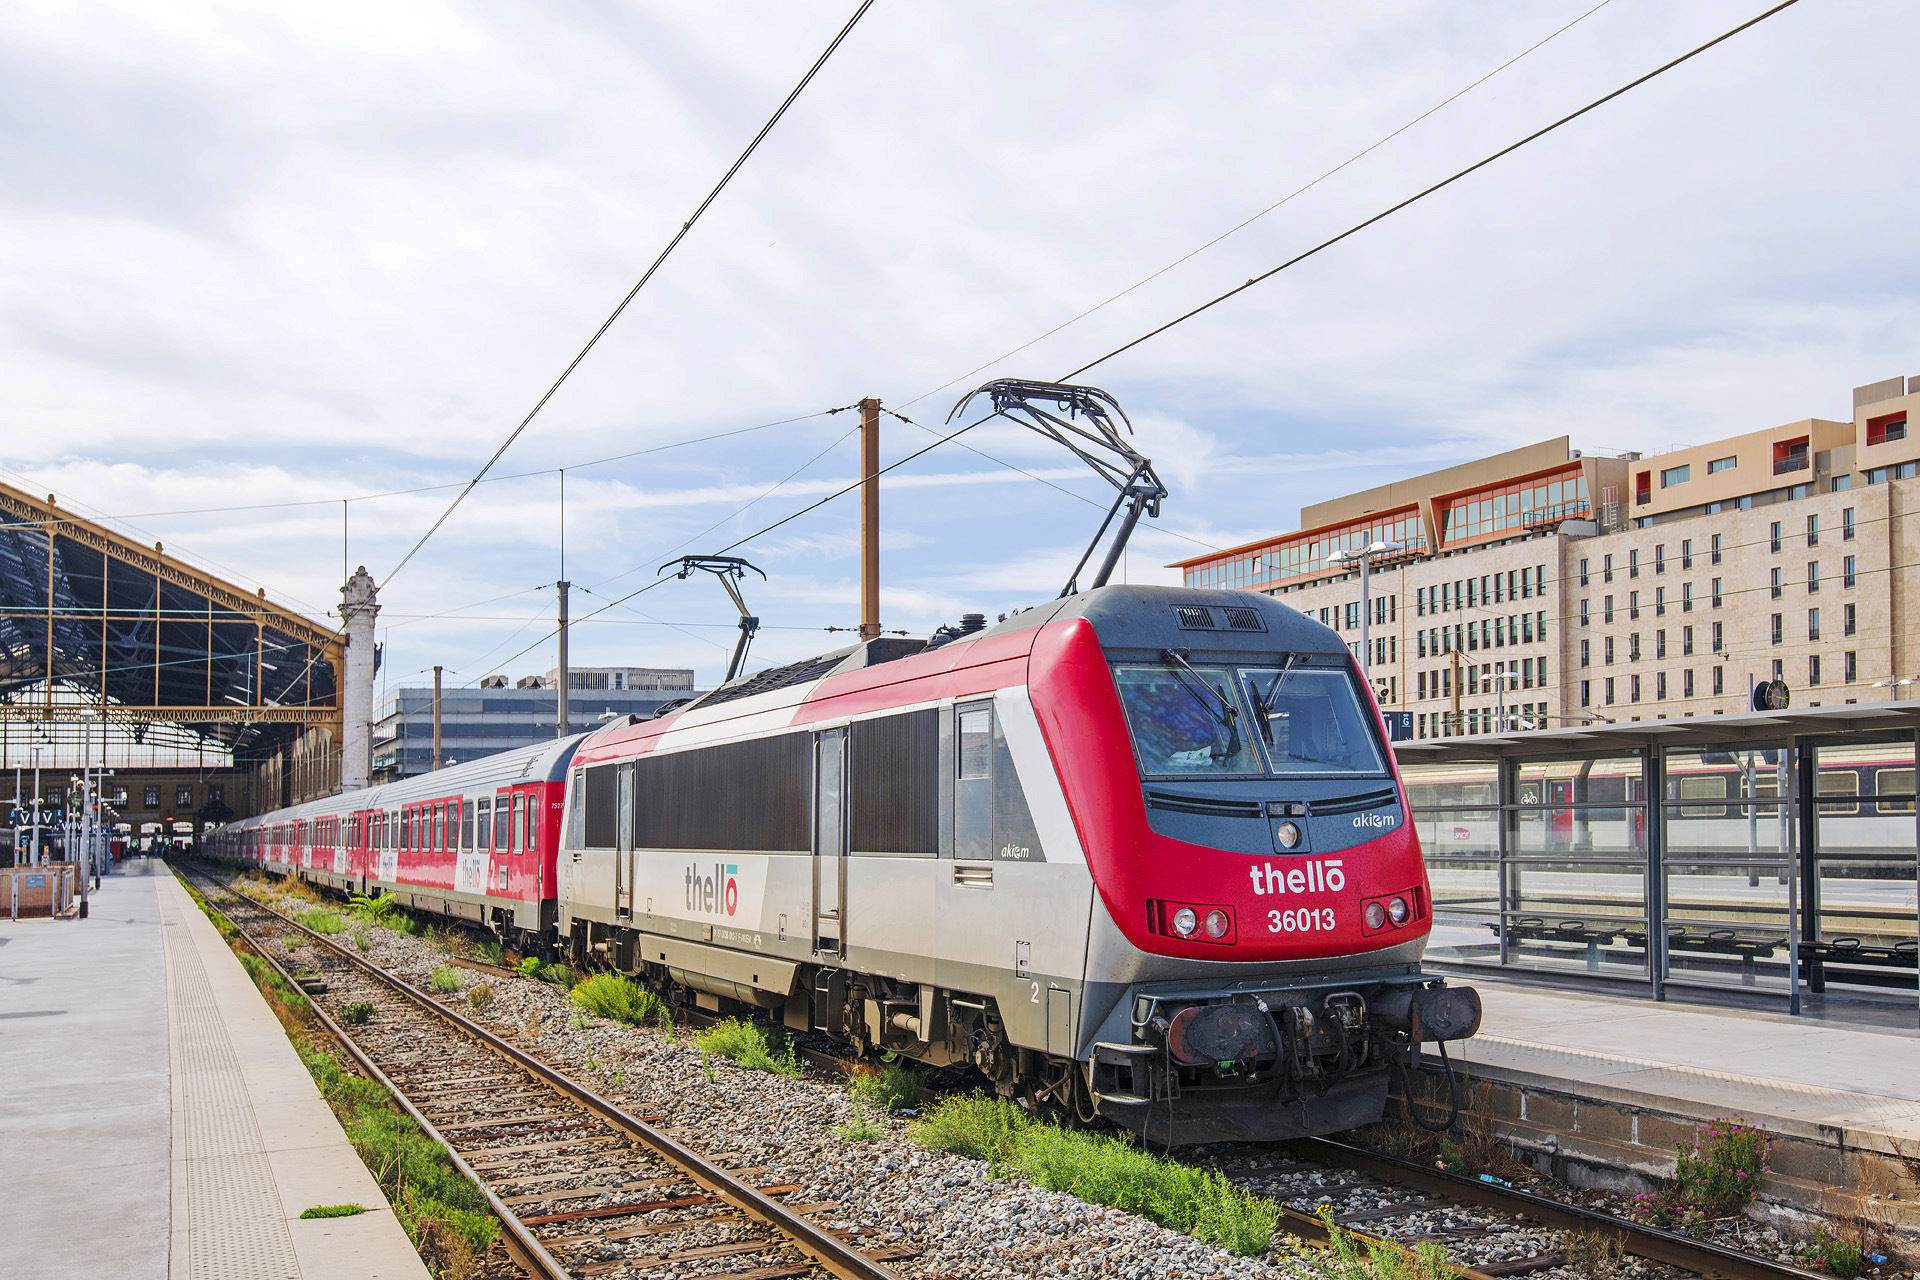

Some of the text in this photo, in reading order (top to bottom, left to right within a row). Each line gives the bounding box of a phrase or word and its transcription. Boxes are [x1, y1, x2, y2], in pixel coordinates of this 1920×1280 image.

[1402, 717, 1410, 726] G
[20, 813, 30, 824] V
[42, 812, 53, 824] V
[1454, 831, 1470, 840] SNCF
[1267, 907, 1336, 933] 36013
[1031, 981, 1039, 1004] 2
